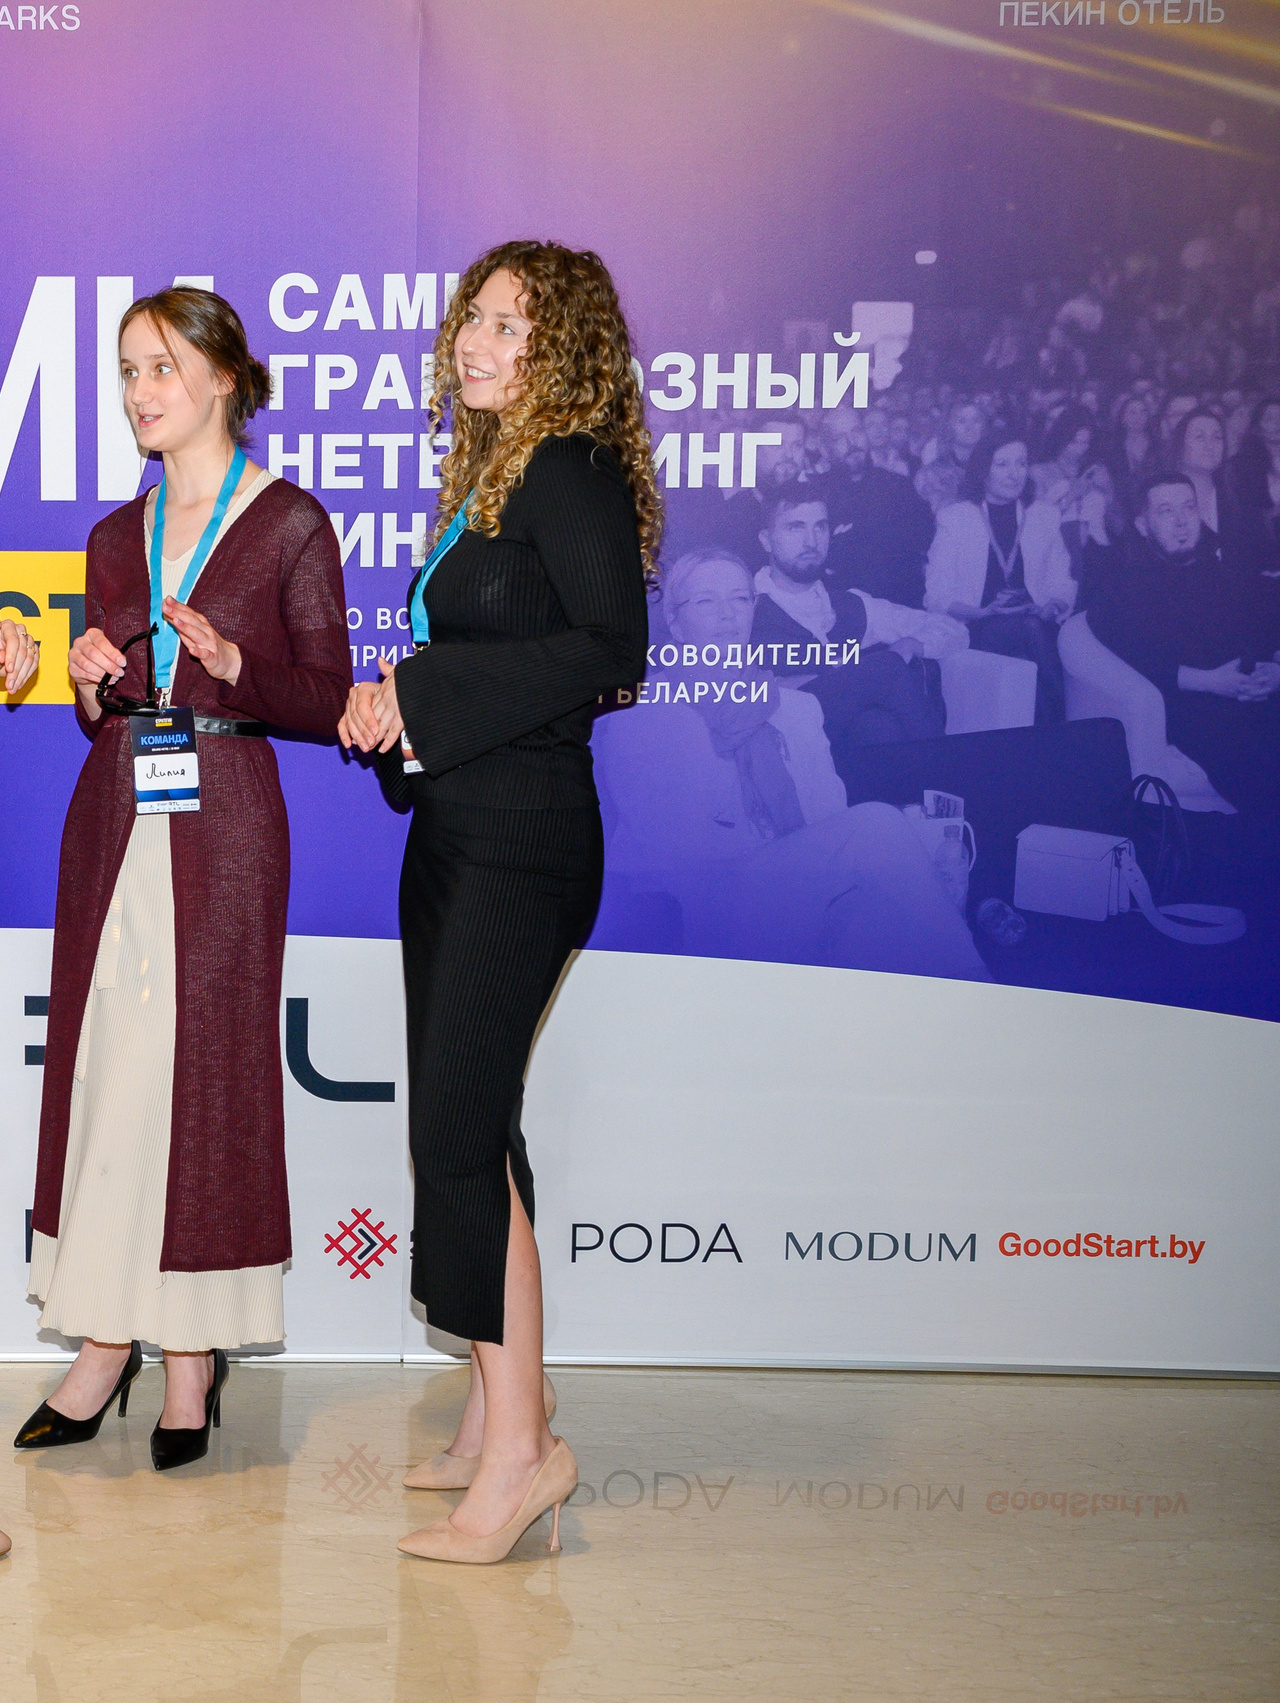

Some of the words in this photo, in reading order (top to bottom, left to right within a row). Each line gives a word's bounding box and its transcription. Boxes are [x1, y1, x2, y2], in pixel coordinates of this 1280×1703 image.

[999, 1, 1105, 26] ПЕКИН
[1118, 0, 1225, 25] ОТЕЛЬ
[141, 733, 189, 746] КОМАНДА
[571, 1222, 743, 1263] PODA
[784, 1231, 977, 1262] MODUM
[998, 1232, 1206, 1264] GoodStart.by
